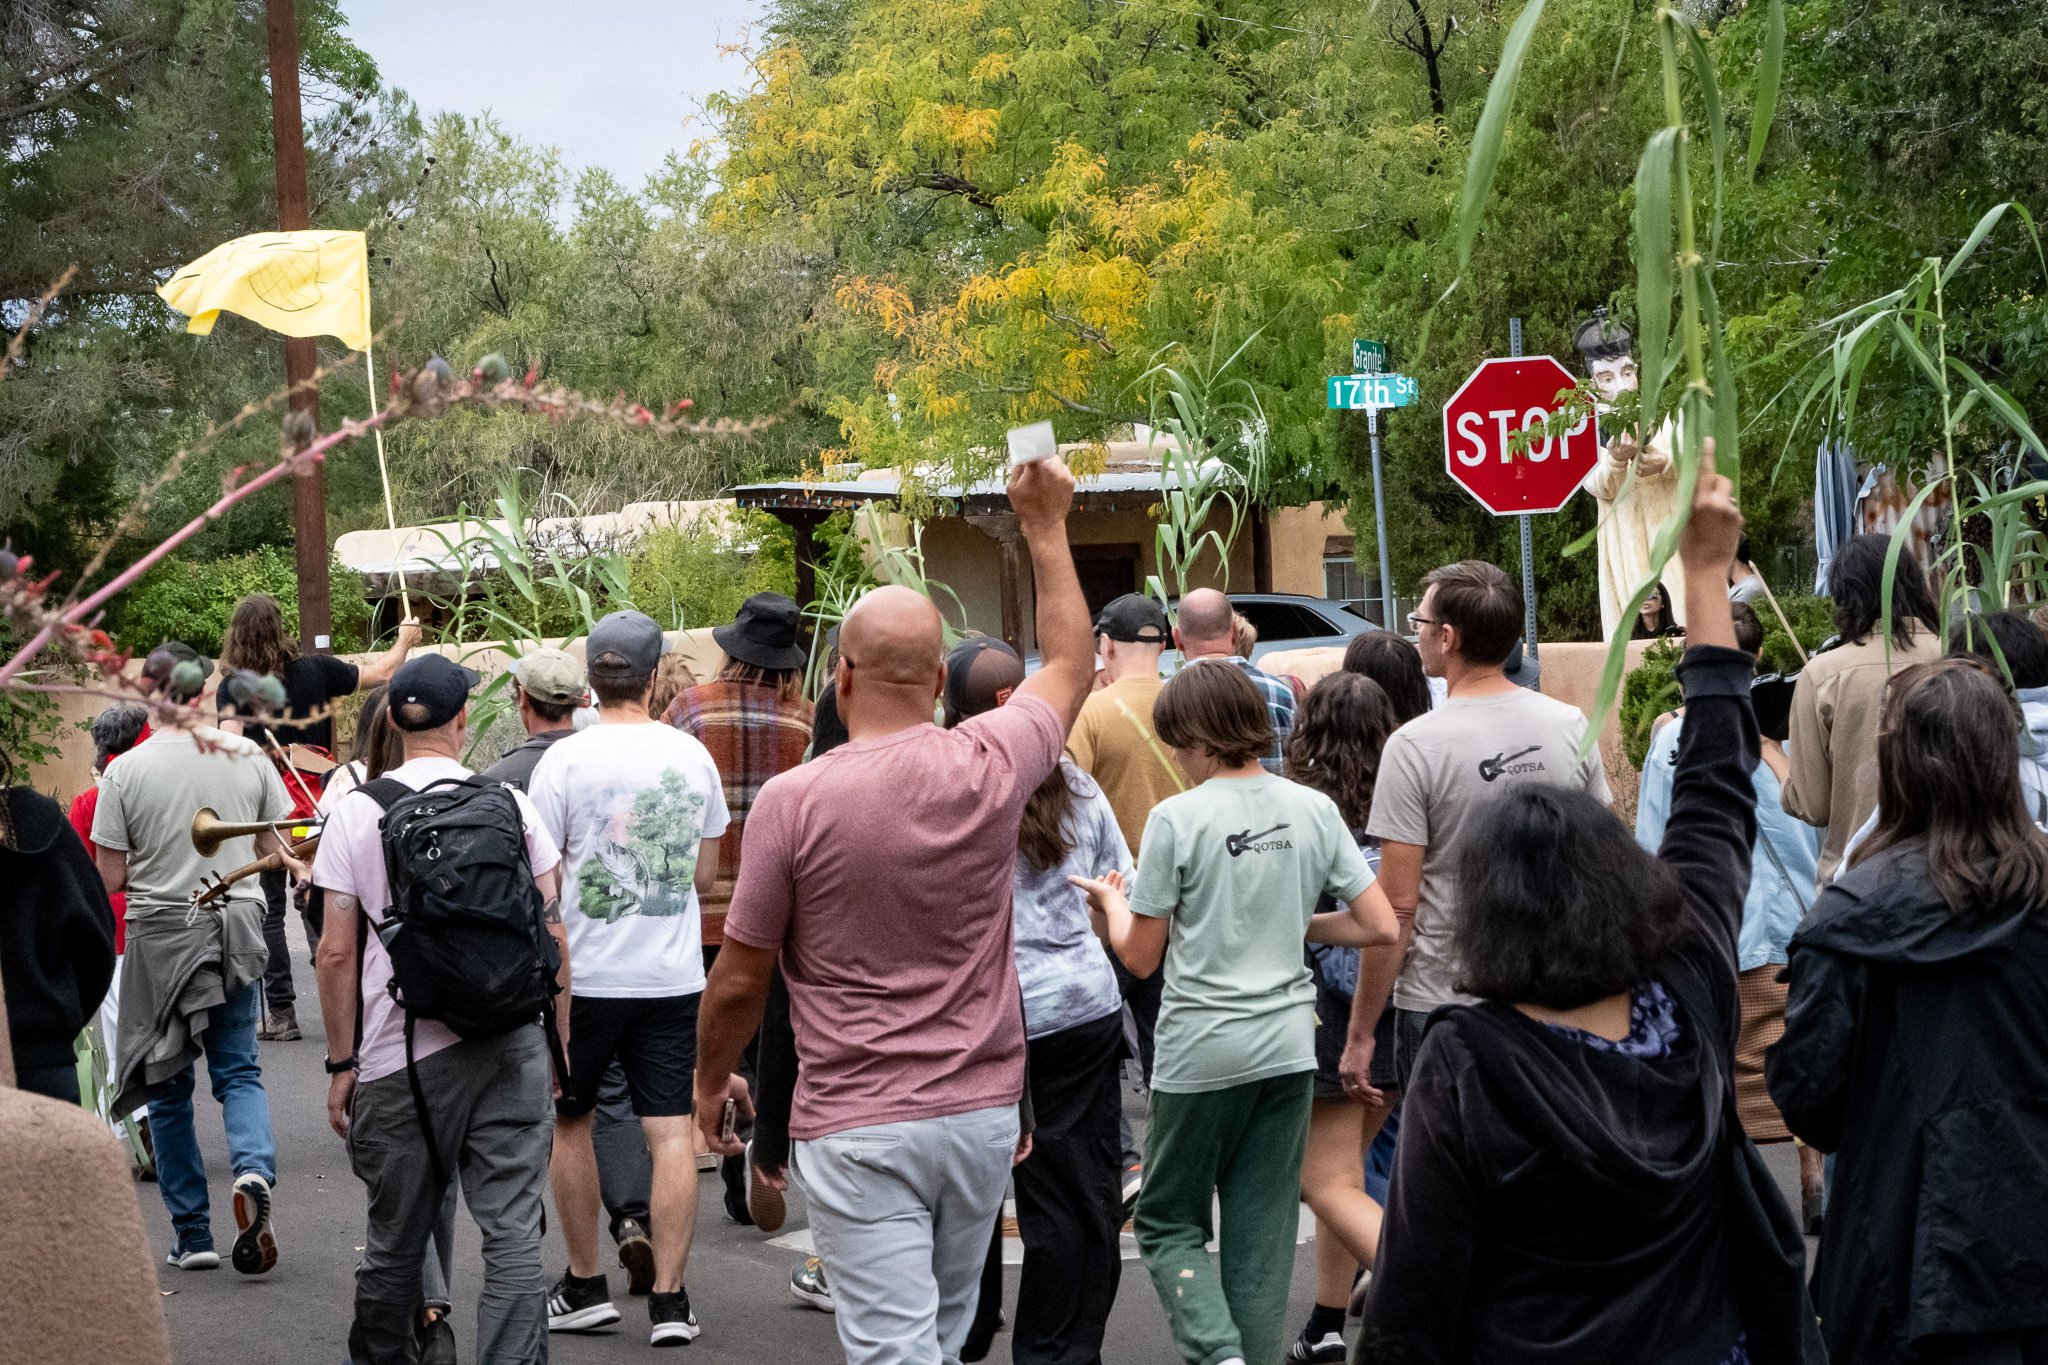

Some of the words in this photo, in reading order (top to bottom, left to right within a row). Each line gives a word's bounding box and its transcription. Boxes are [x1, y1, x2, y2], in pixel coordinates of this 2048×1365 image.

[1355, 343, 1381, 371] Granite
[1333, 380, 1389, 405] 17th
[1396, 377, 1414, 394] St
[1456, 406, 1588, 466] STOP
[1507, 762, 1545, 775] QOTSA
[1253, 840, 1293, 854] QOTSA
